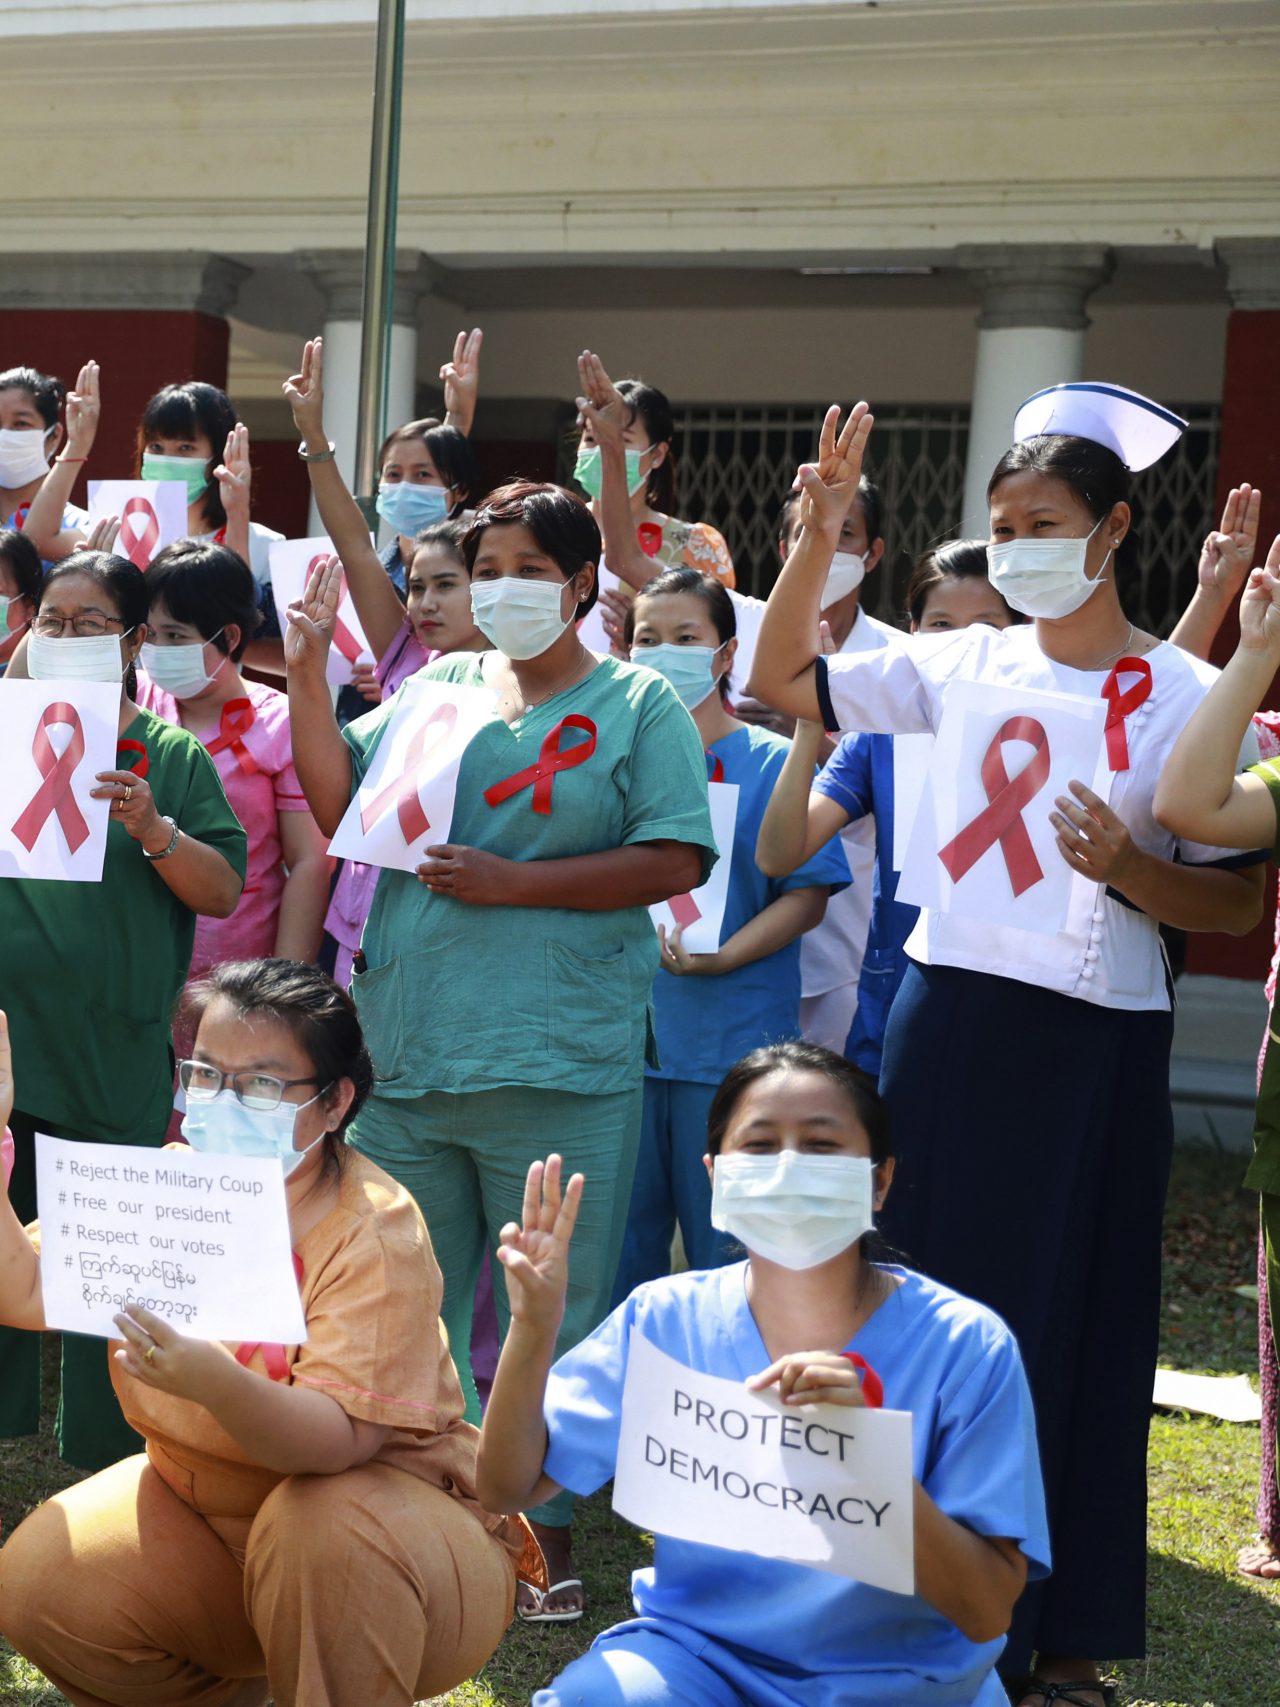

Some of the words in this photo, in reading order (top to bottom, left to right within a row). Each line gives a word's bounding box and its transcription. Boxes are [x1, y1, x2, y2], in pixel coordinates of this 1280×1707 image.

[55, 1159, 64, 1172] #
[70, 1160, 118, 1181] Reject
[123, 1166, 149, 1183] the
[155, 1169, 213, 1193] Military
[220, 1176, 263, 1196] Coup
[58, 1190, 67, 1204] #
[74, 1193, 107, 1211] Free
[118, 1201, 144, 1214] our
[156, 1204, 232, 1224] president
[61, 1223, 70, 1237] #
[77, 1224, 139, 1245] Respect
[149, 1235, 175, 1249] our
[181, 1240, 225, 1256] votes
[65, 1255, 73, 1268] #
[673, 1389, 854, 1462] PROTECT
[645, 1434, 891, 1527] DEMOCRACY
